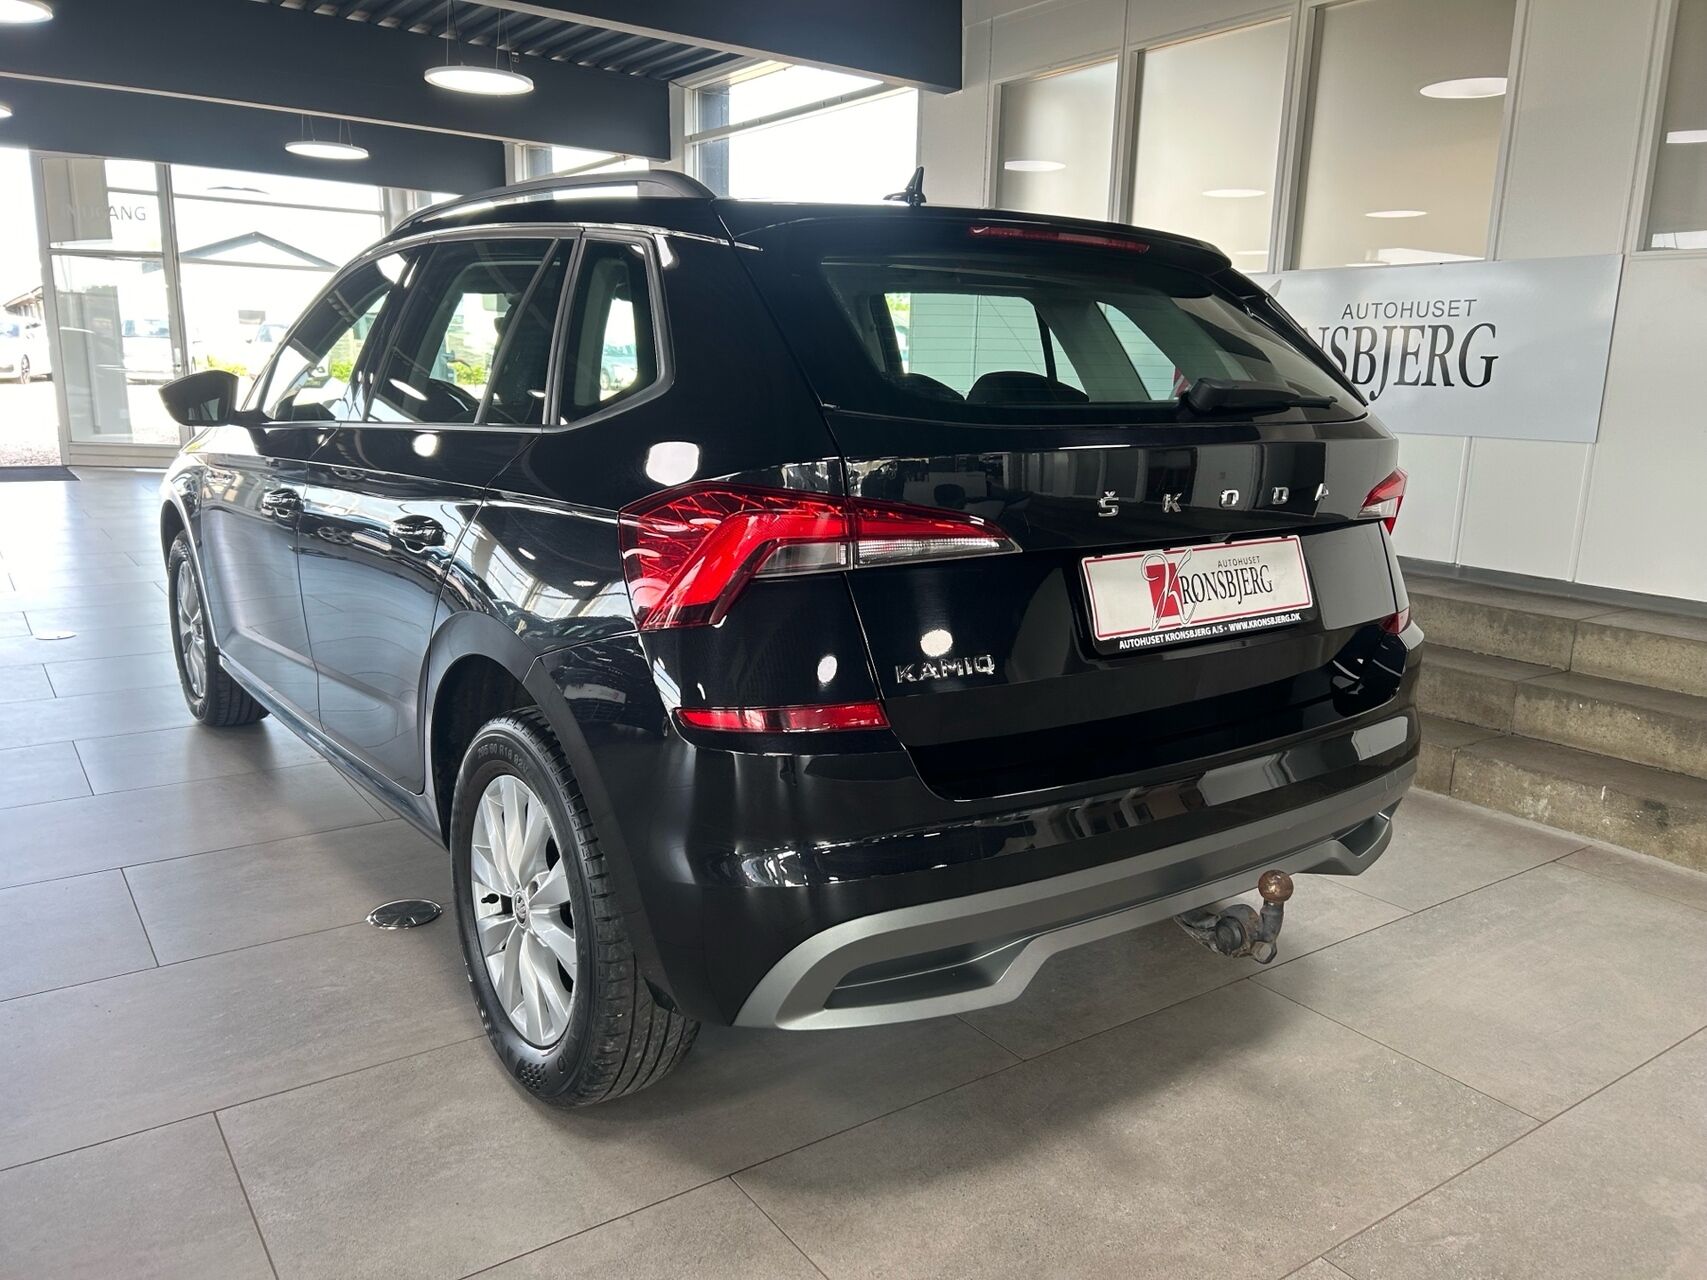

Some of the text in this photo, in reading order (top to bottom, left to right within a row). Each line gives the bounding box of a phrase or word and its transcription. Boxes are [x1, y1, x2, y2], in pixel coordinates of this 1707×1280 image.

[1341, 299, 1477, 320] AUTOHUSET
[1303, 323, 1499, 401] SBJERG
[1098, 483, 1329, 518] ŠKODA
[1217, 556, 1261, 569] AUTOHUSET
[1119, 612, 1302, 650] AUTOHUSET KRONSBJERG A/S WWW.KRONSBJERG.DK
[895, 654, 996, 684] KAMIQ
